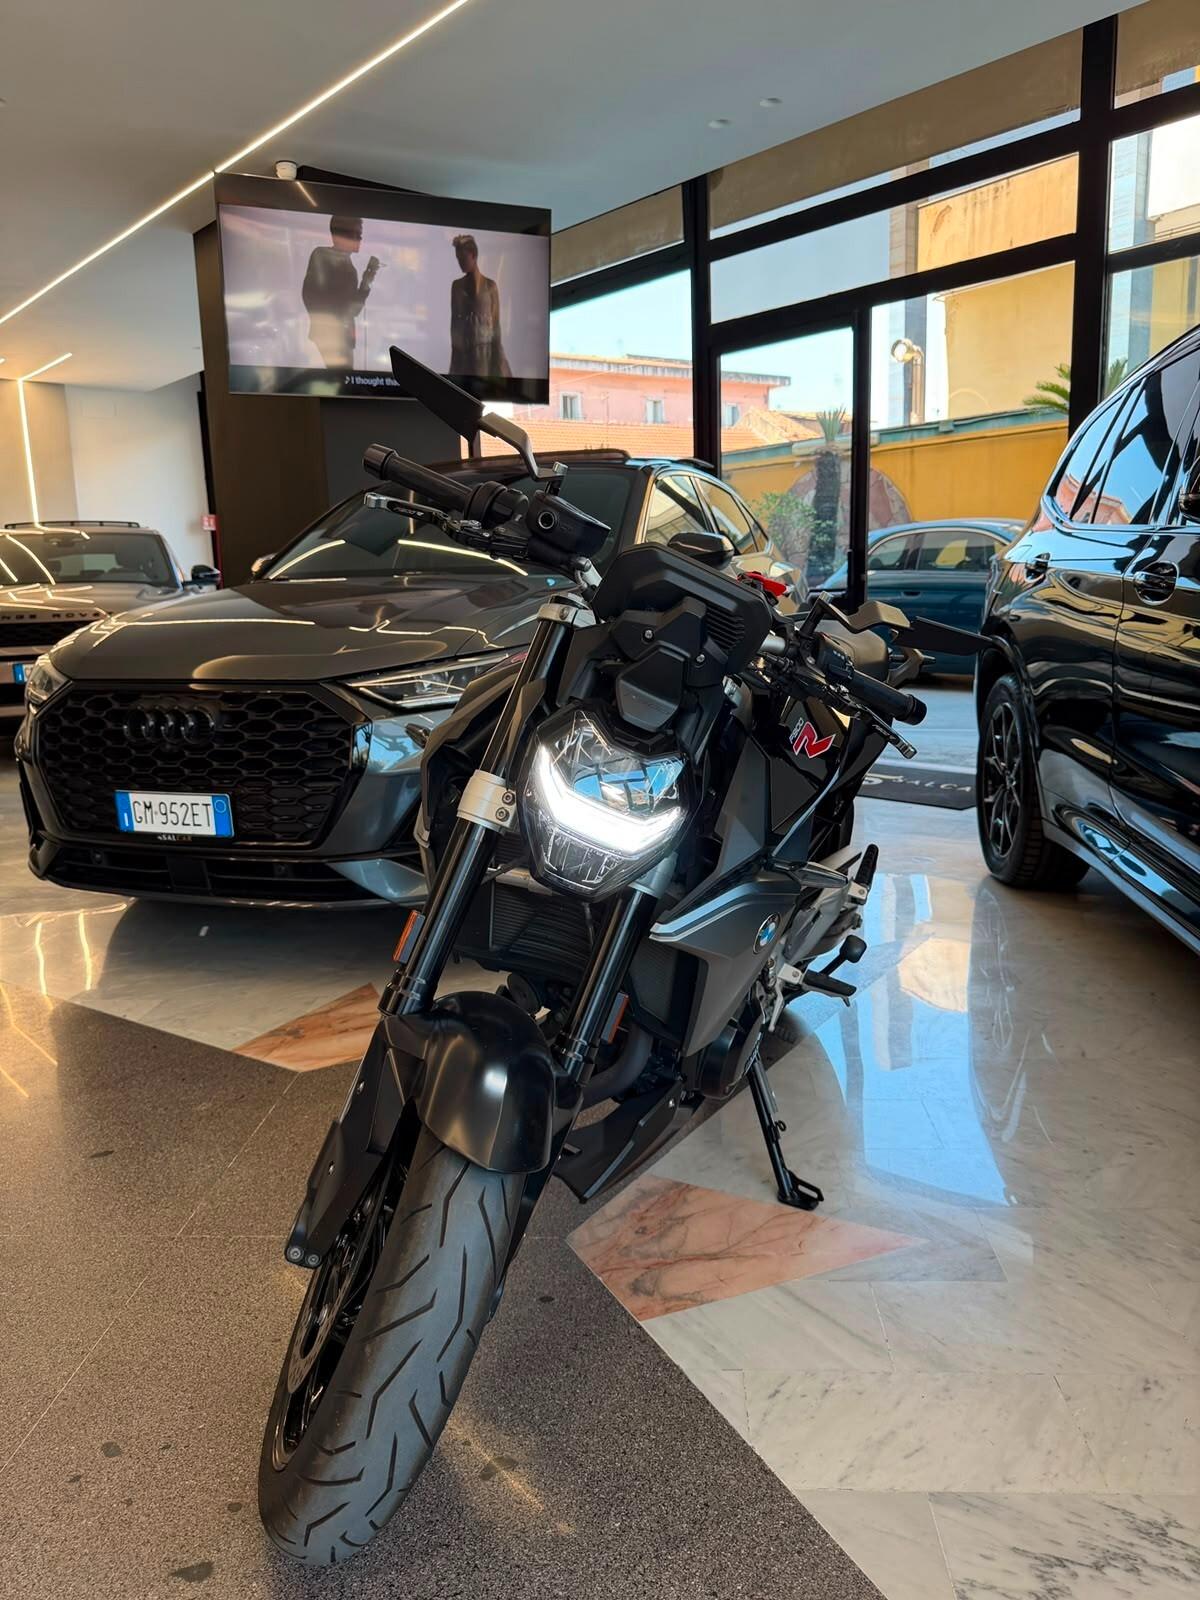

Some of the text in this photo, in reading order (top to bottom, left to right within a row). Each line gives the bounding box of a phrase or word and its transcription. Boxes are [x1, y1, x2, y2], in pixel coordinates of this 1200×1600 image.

[355, 376, 384, 387] thought
[385, 377, 400, 386] tha
[792, 721, 836, 758] R
[892, 776, 972, 792] SALCA
